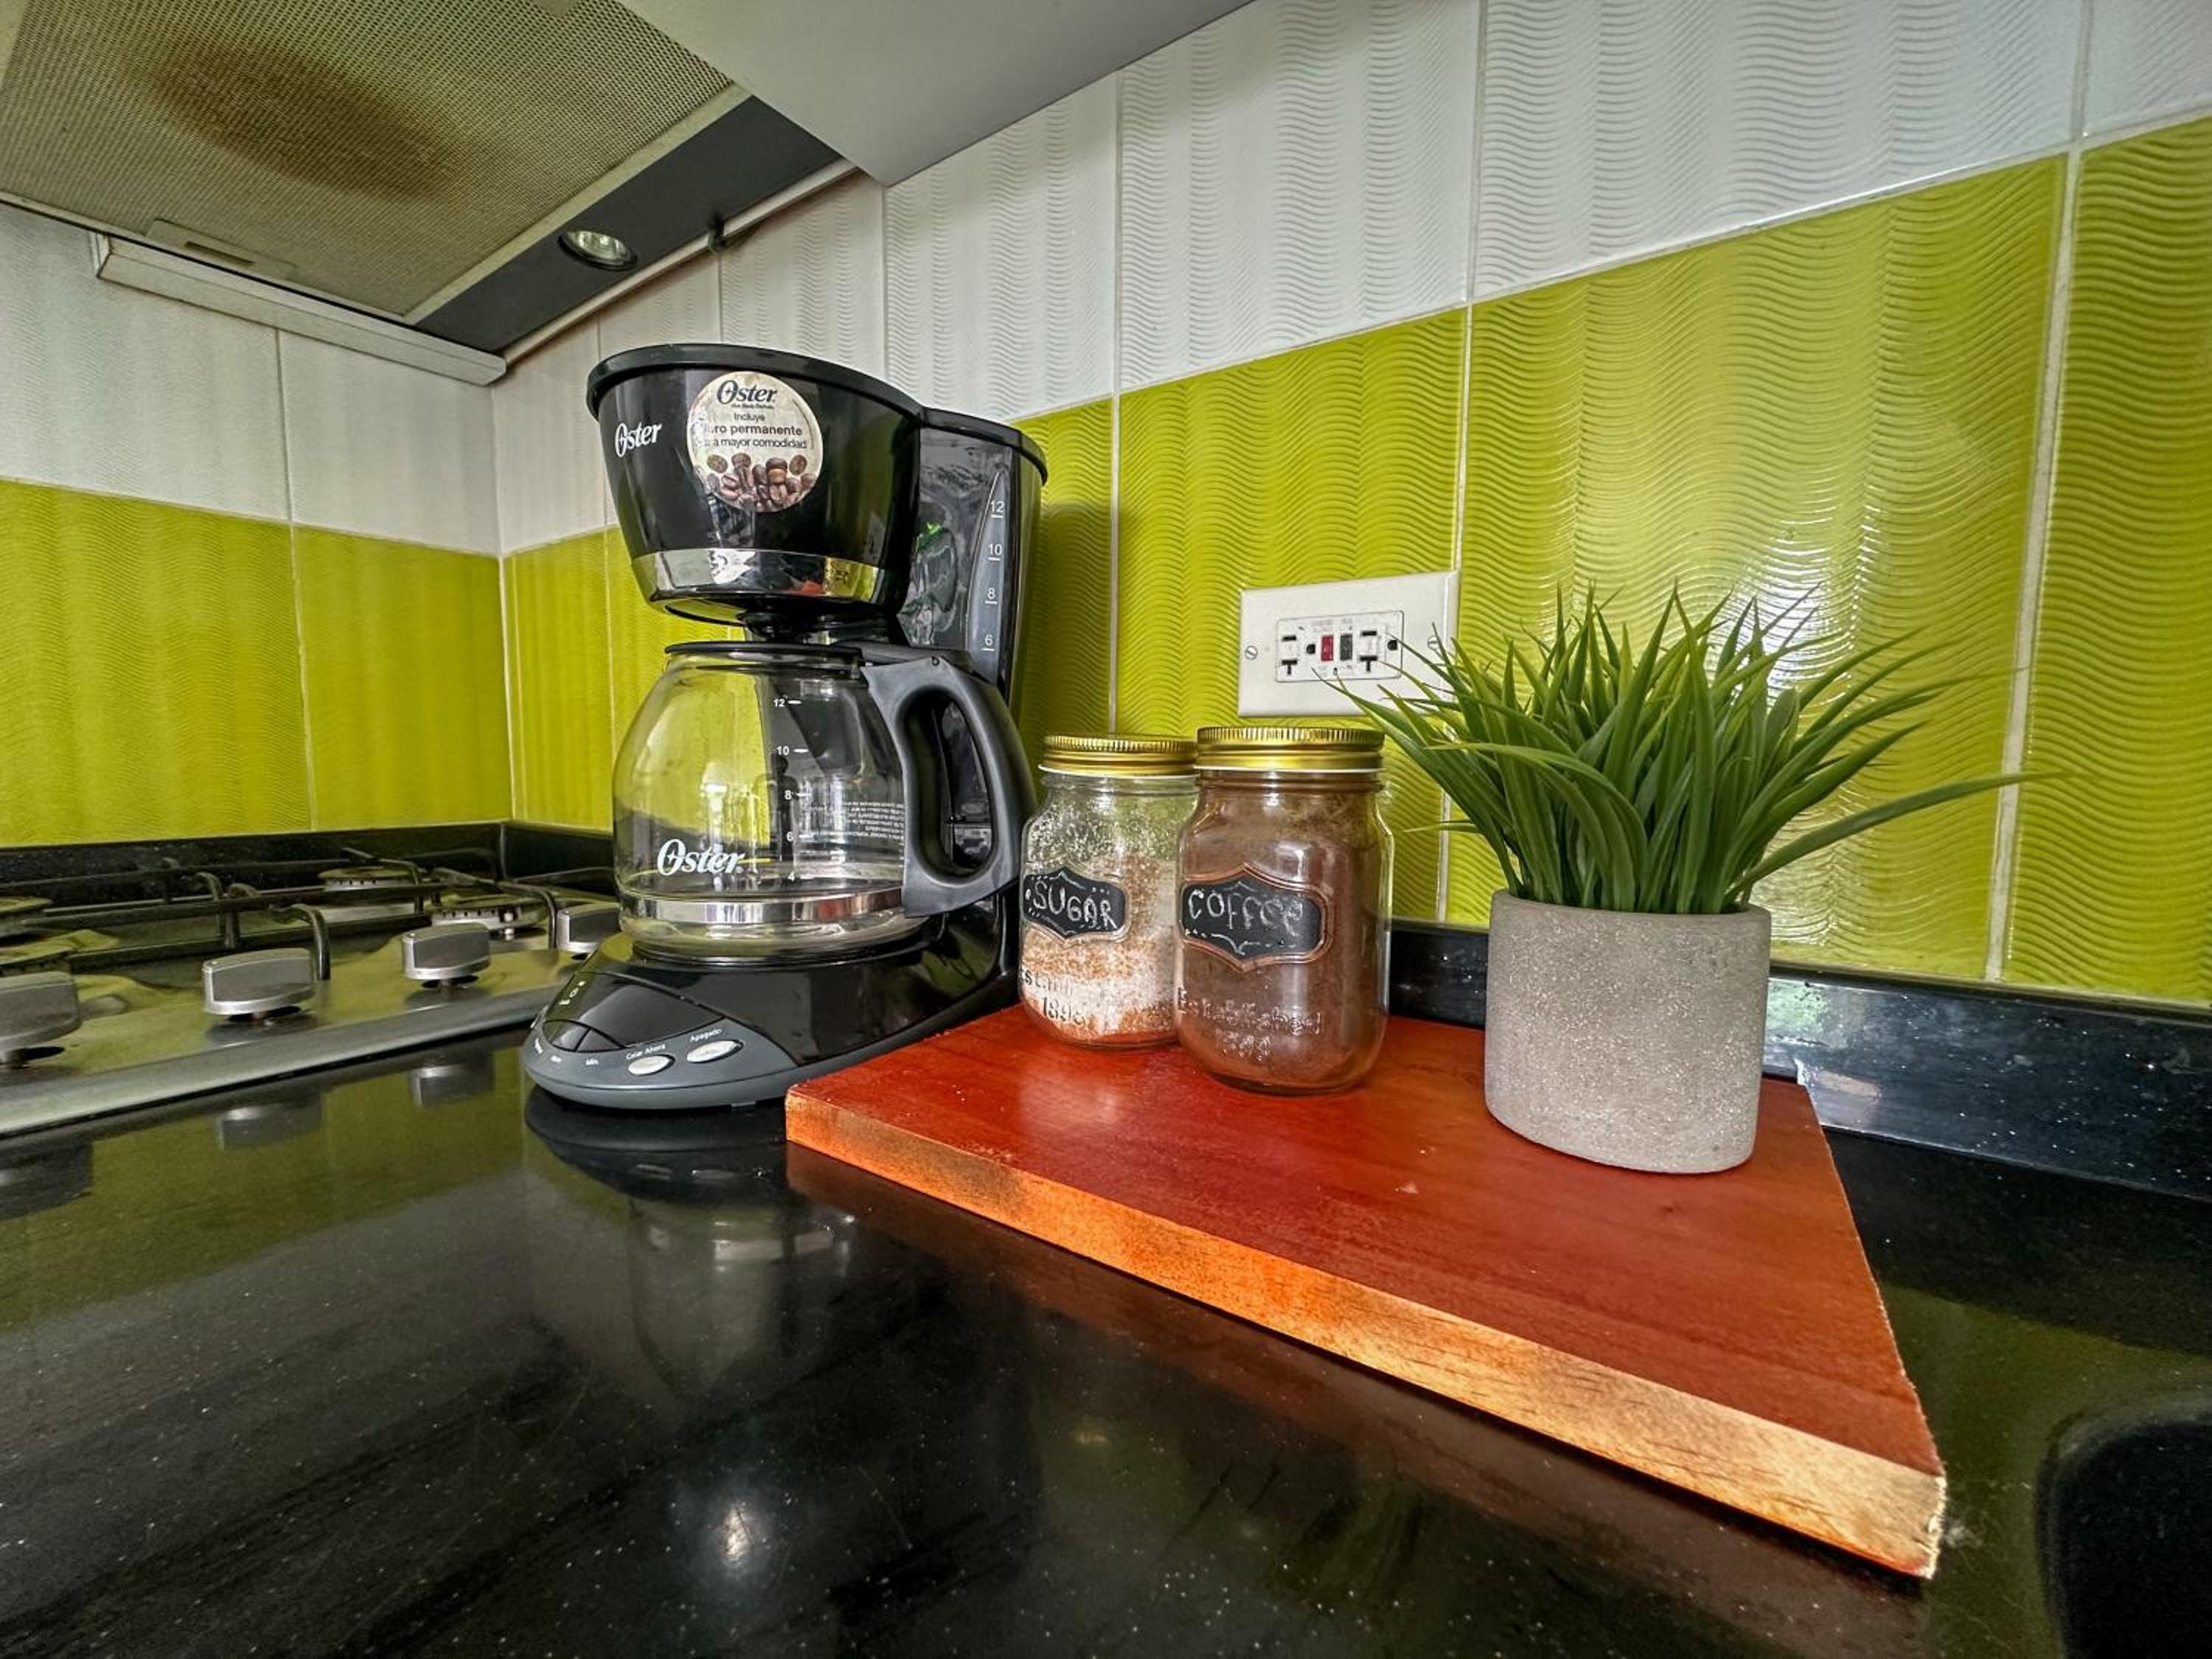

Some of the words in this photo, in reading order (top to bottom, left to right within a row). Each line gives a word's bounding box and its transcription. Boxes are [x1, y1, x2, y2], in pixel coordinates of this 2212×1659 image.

[717, 380, 778, 405] Oster
[734, 412, 765, 422] Incluye
[731, 425, 803, 437] permanente
[615, 422, 663, 458] Oster
[720, 439, 751, 448] mayor
[753, 438, 807, 449] comodidad
[990, 501, 1004, 512] 12
[989, 543, 1003, 554] 10
[987, 588, 995, 599] 8
[984, 635, 993, 646] 6
[773, 698, 785, 707] 12
[776, 745, 790, 755] 10
[784, 790, 792, 800] 8
[787, 832, 794, 841] 6
[657, 838, 745, 876] Oster
[1033, 880, 1118, 930] SUGAR
